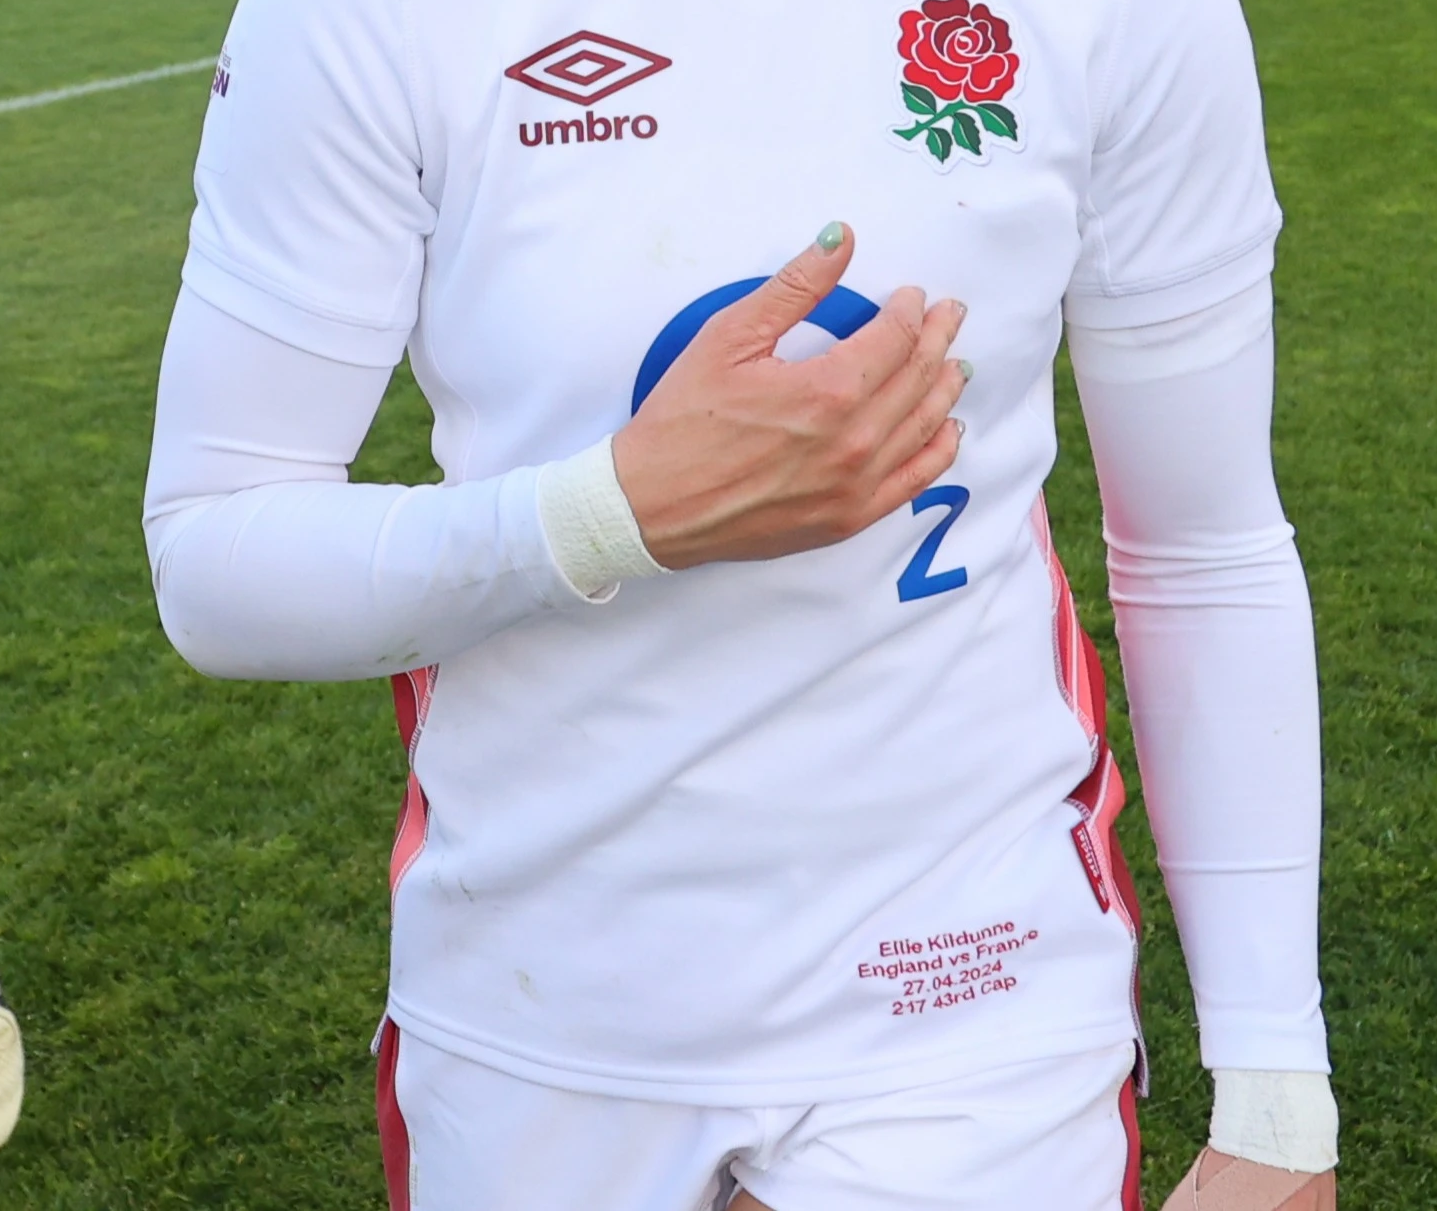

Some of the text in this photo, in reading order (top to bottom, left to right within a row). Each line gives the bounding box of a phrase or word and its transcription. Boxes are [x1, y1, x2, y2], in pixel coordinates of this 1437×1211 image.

[519, 110, 658, 147] umbro
[879, 921, 1015, 957] Ellie Kildunne
[858, 955, 943, 979] England
[948, 953, 970, 967] vs
[903, 959, 1003, 996] 27.04.2024
[892, 976, 1017, 1016] 217 43rd Cap
